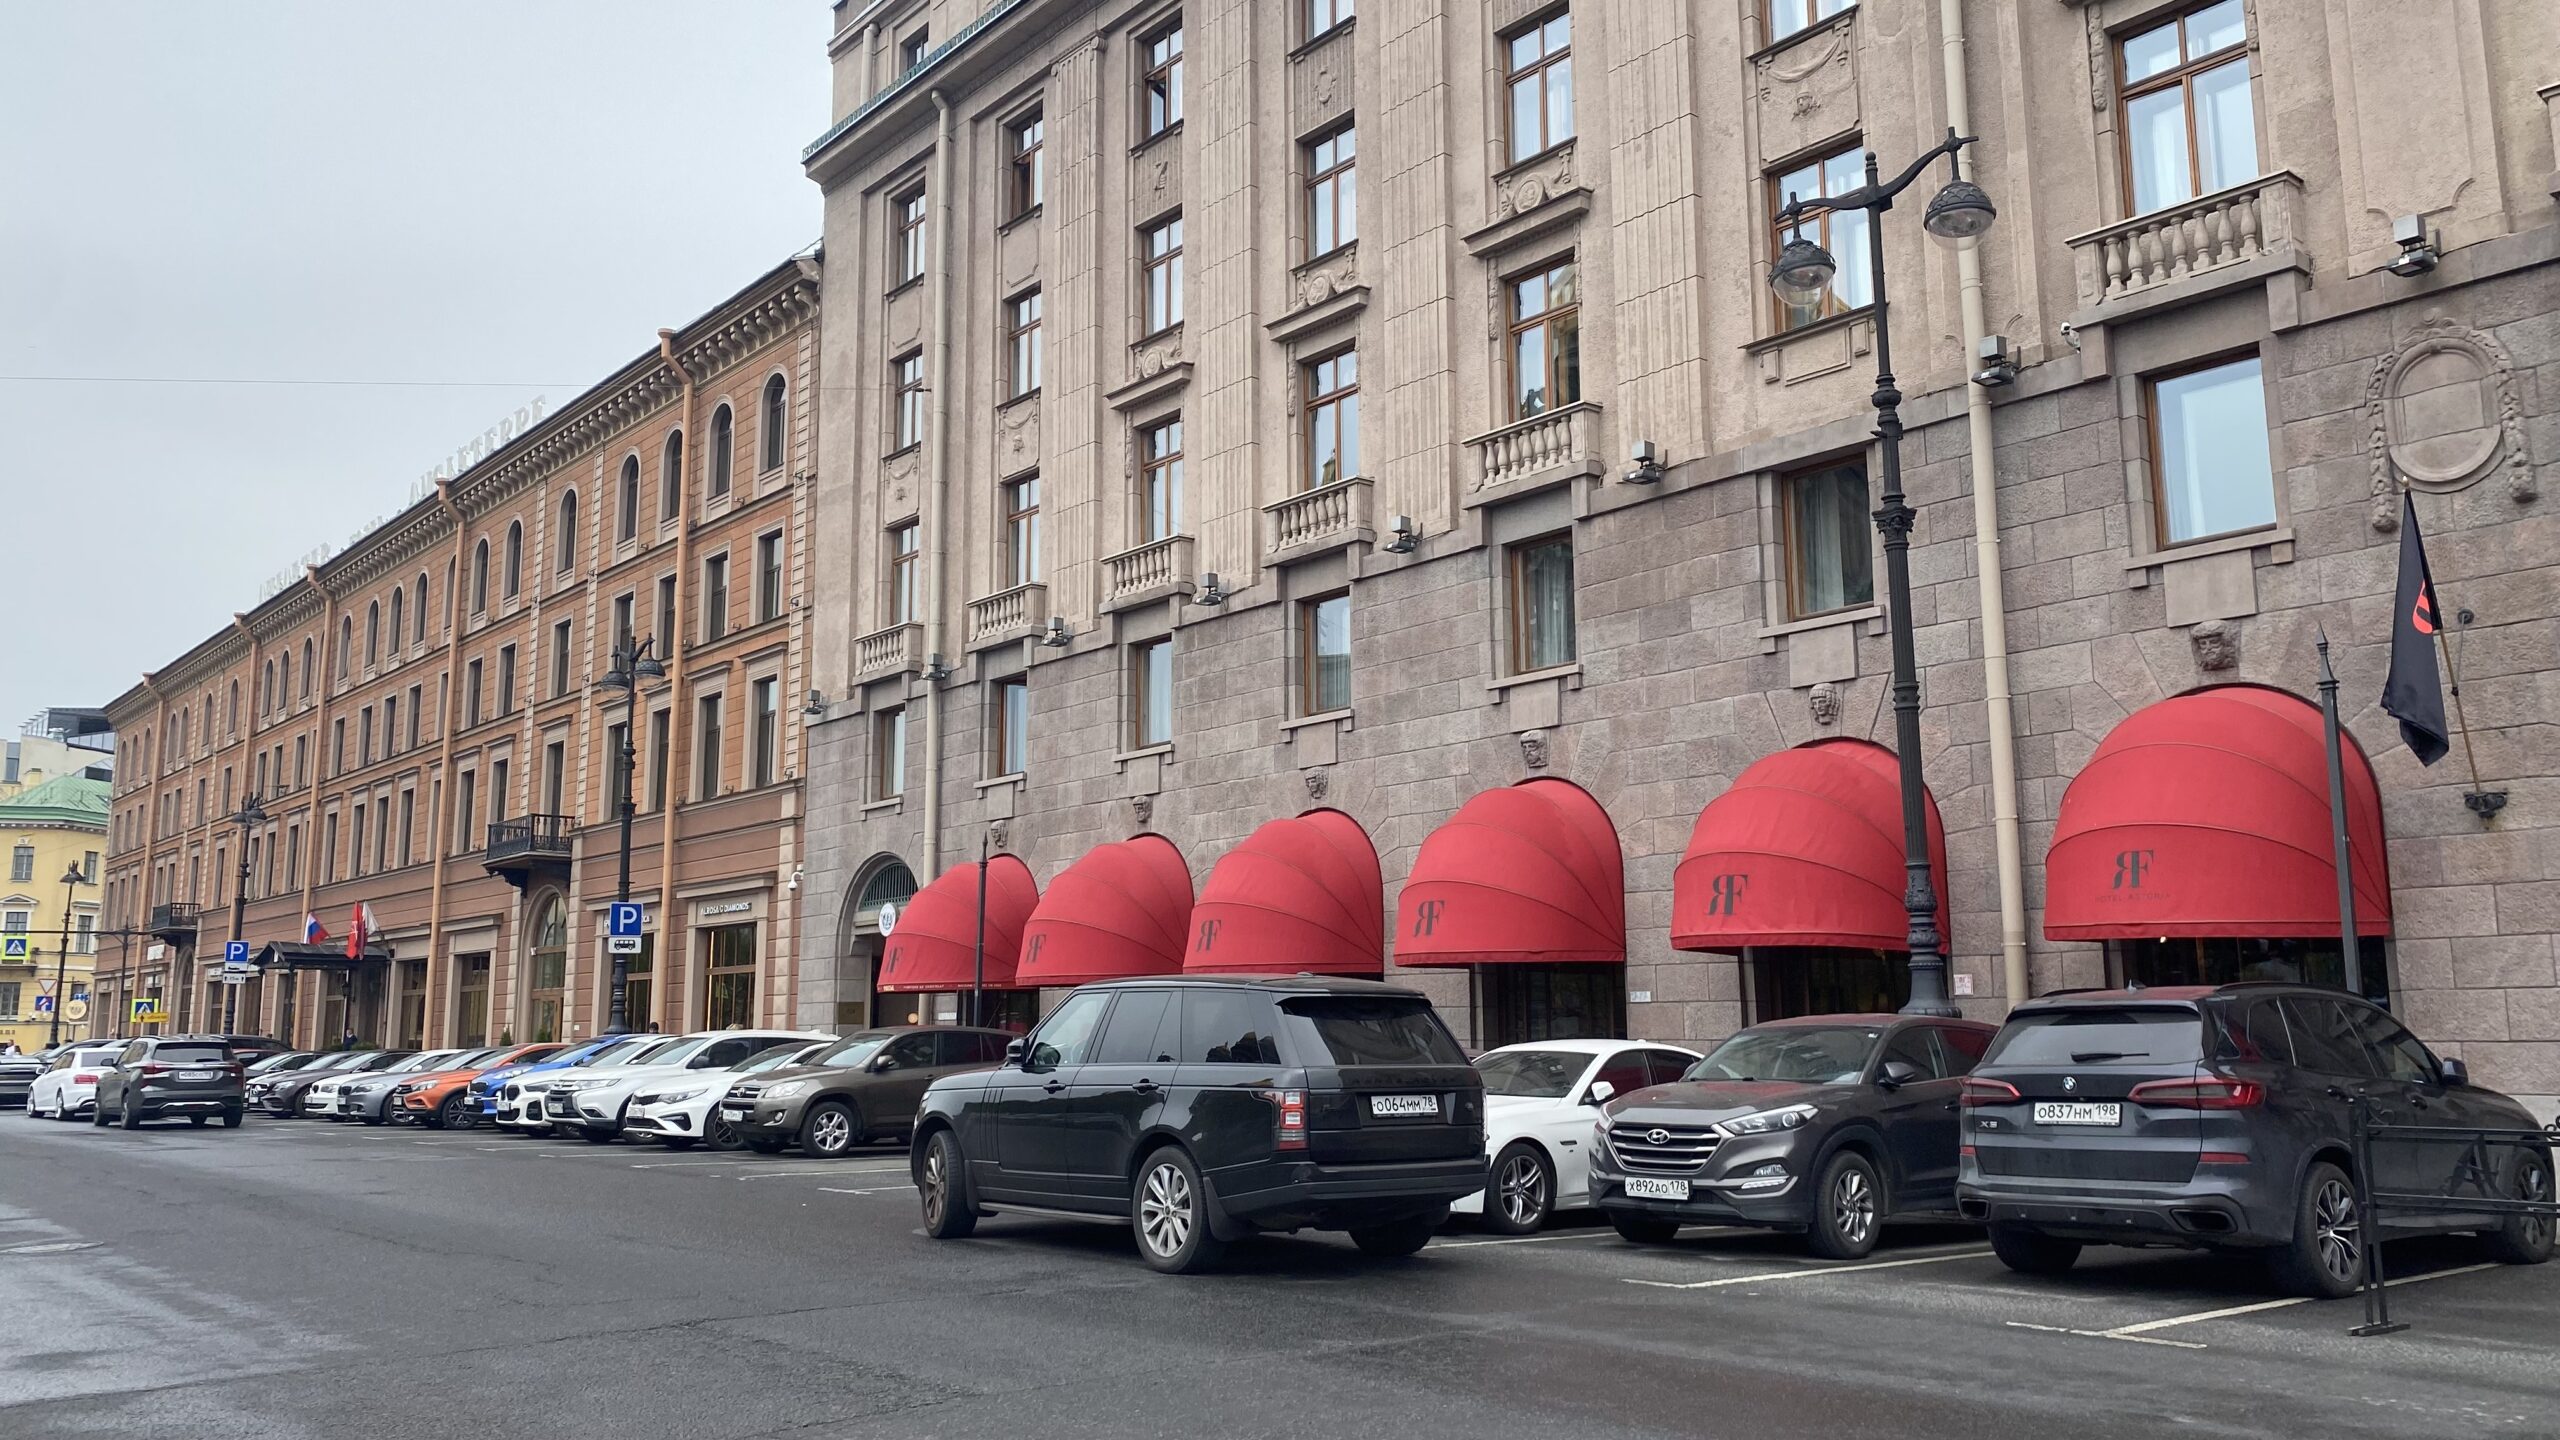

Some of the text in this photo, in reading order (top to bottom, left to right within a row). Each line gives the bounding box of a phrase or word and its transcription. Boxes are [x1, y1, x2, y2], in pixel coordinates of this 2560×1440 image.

[619, 906, 638, 932] P
[230, 943, 244, 960] P
[1979, 1120, 1998, 1129] X5
